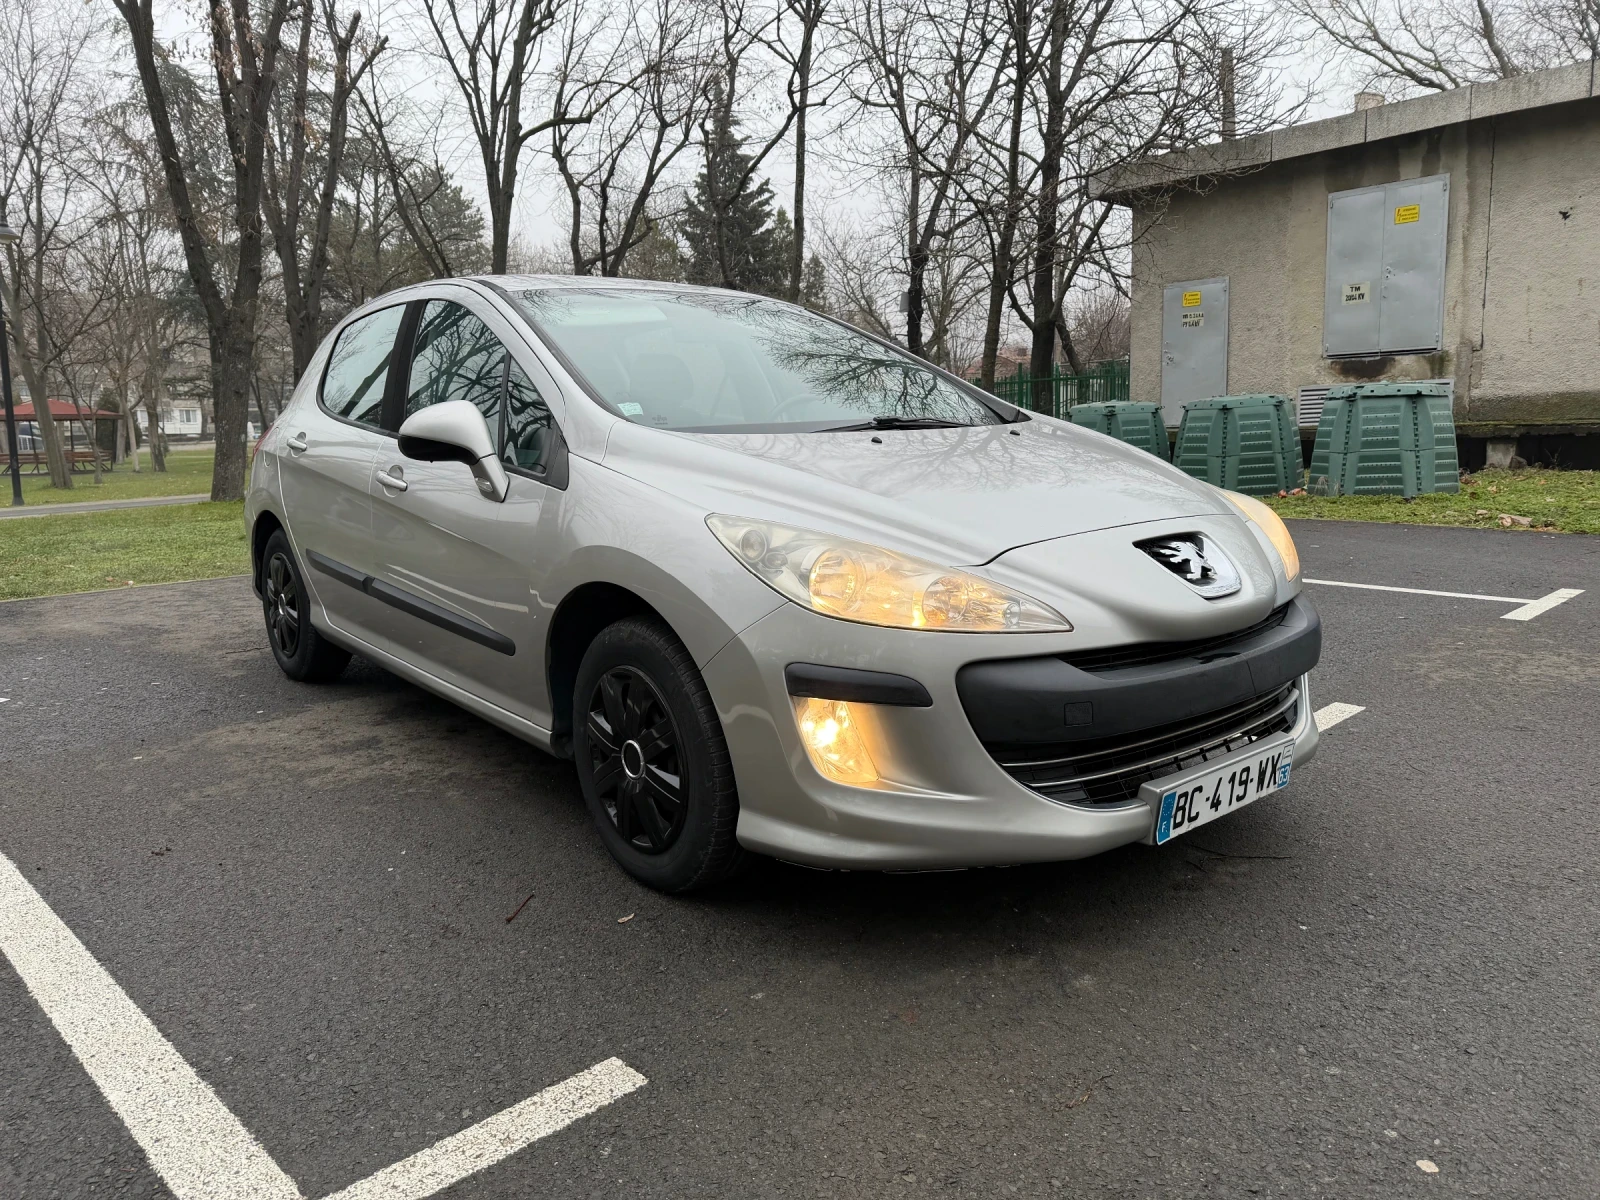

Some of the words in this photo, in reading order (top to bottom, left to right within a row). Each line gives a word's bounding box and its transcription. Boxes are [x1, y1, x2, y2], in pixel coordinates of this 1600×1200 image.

[1278, 765, 1290, 785] 63
[1172, 752, 1282, 830] BC-419-WX
[1161, 821, 1168, 833] F
